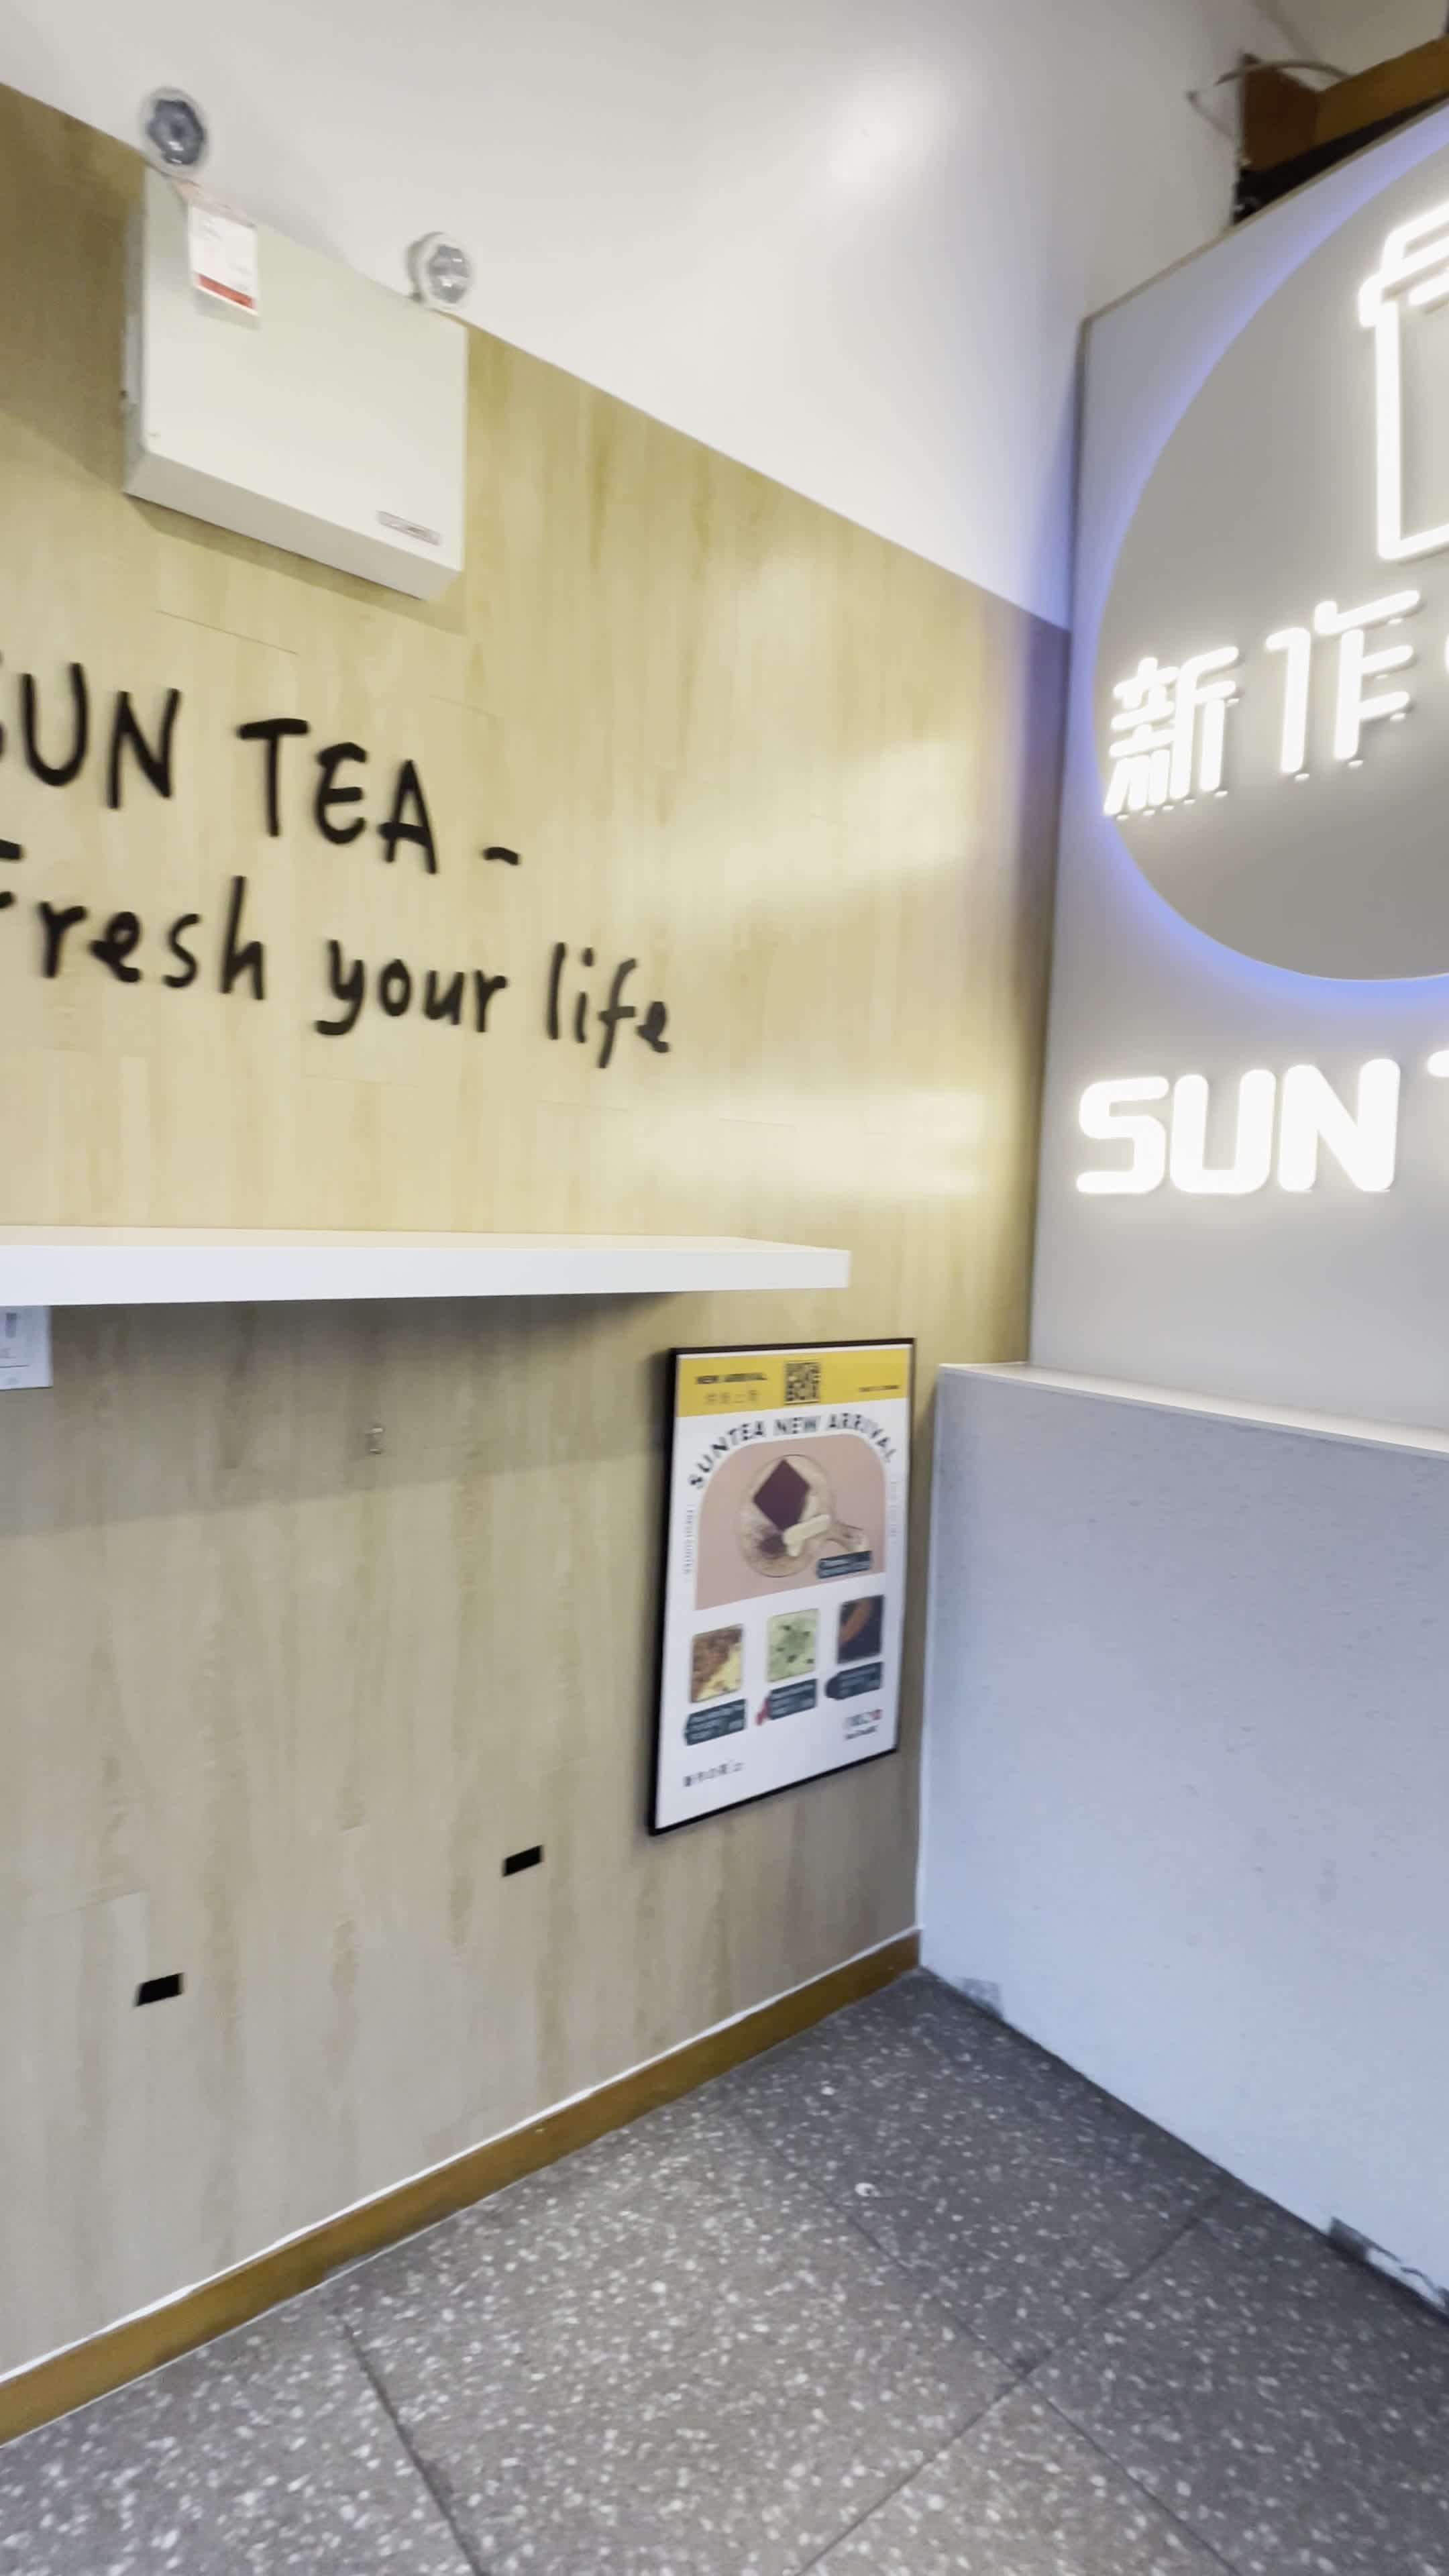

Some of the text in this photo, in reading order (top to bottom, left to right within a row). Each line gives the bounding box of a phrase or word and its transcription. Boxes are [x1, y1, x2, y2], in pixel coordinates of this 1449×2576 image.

[0, 649, 180, 809] UN
[237, 717, 438, 874] TEA
[1103, 590, 1449, 816] 新作
[315, 938, 508, 1036] your
[545, 941, 671, 1069] life
[1076, 1058, 1401, 1195] SUN
[773, 1415, 821, 1436] NEW
[825, 1412, 896, 1463] ARRIVAL
